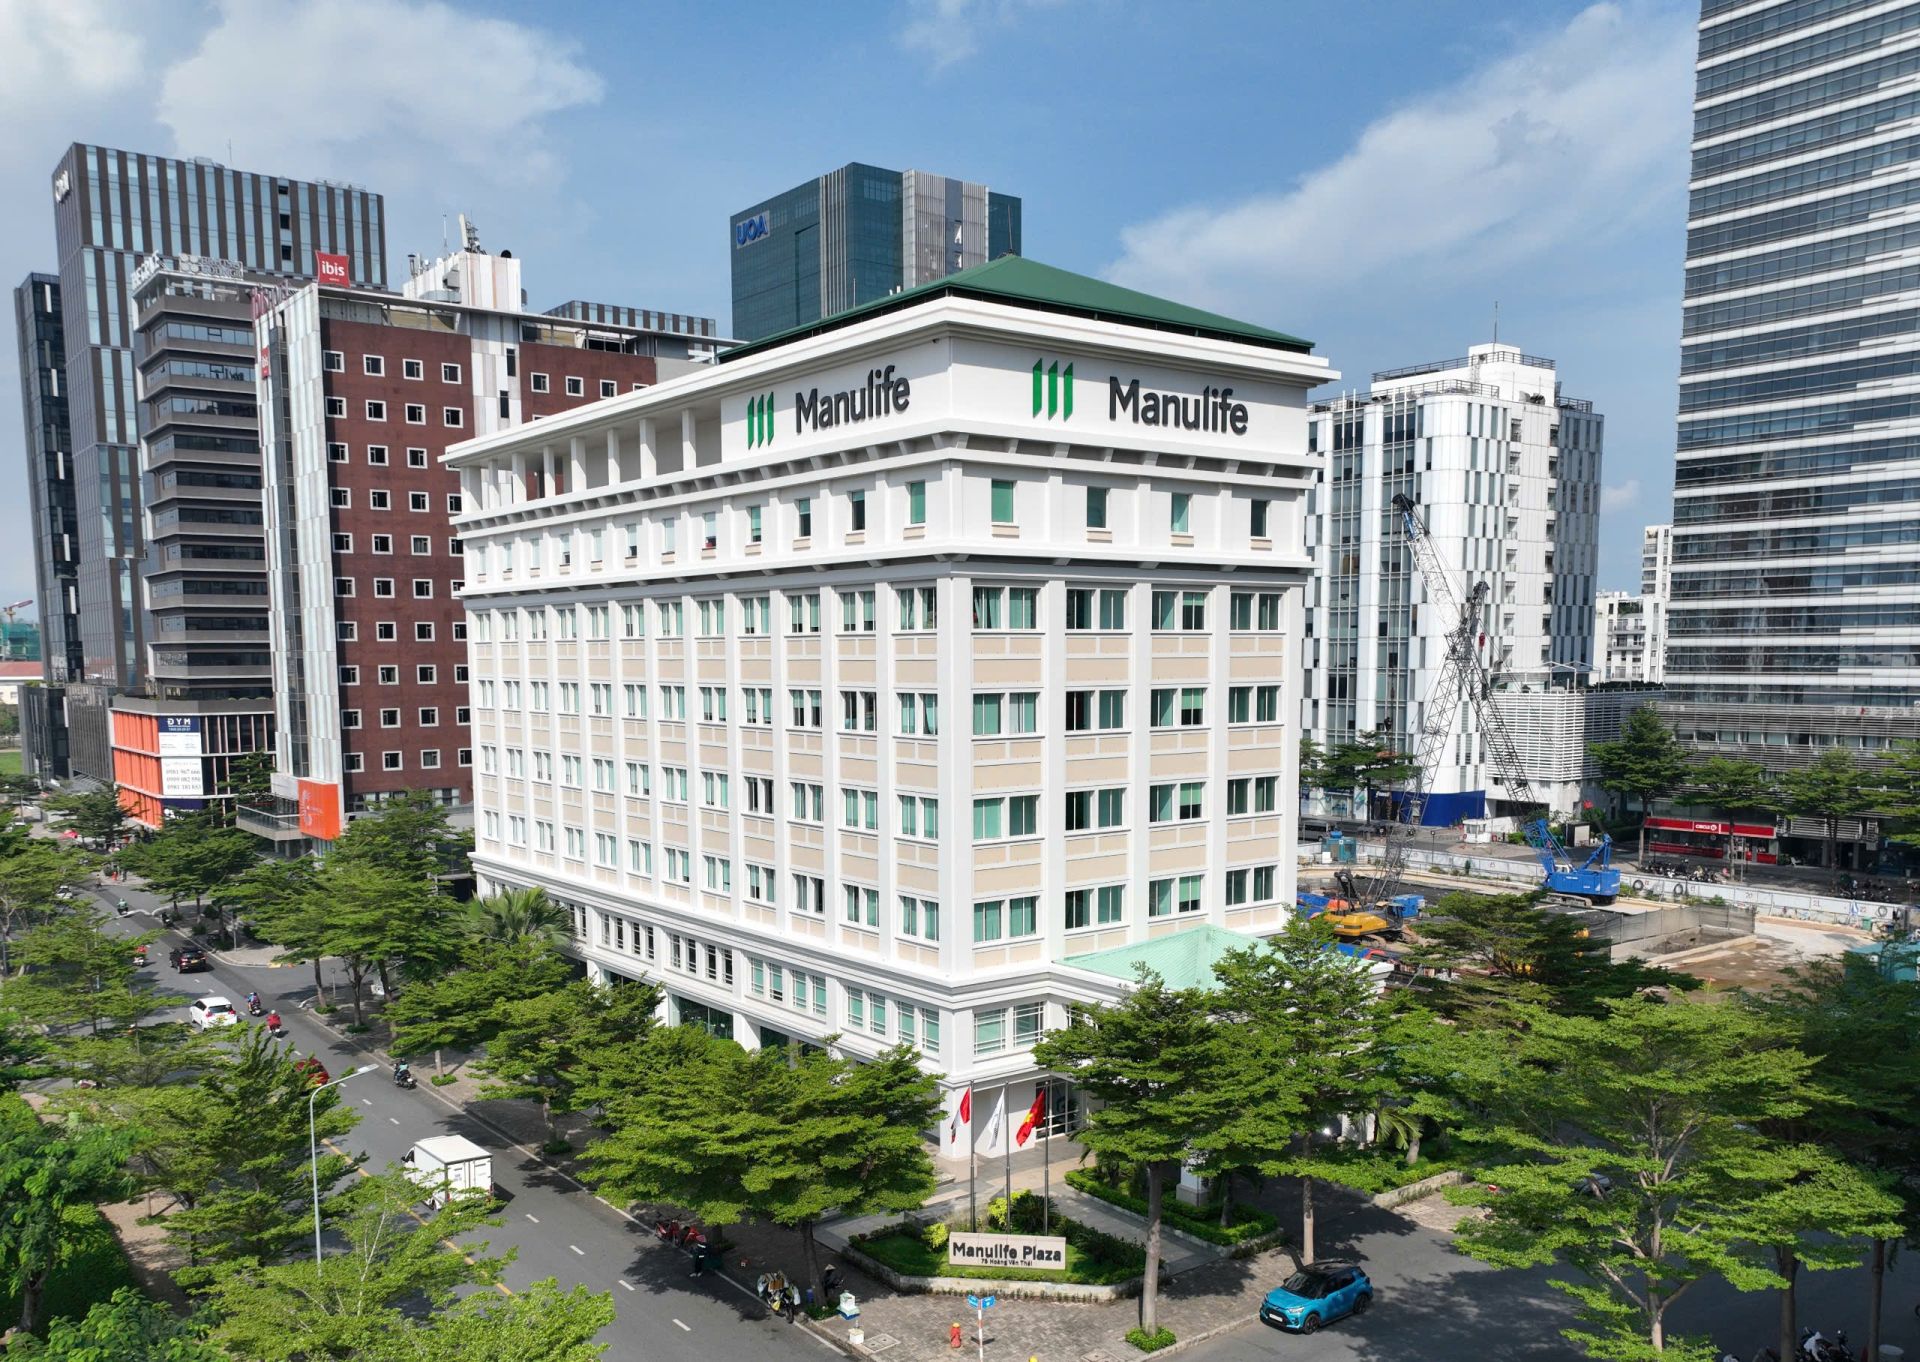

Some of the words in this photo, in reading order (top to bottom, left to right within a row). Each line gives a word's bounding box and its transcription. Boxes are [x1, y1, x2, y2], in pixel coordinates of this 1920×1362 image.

[736, 215, 768, 245] UOA
[321, 260, 345, 277] ibis
[796, 364, 910, 434] Manulife
[1109, 375, 1249, 435] Manulife
[953, 1242, 1017, 1259] Manulife
[1023, 1245, 1061, 1262] Plaza
